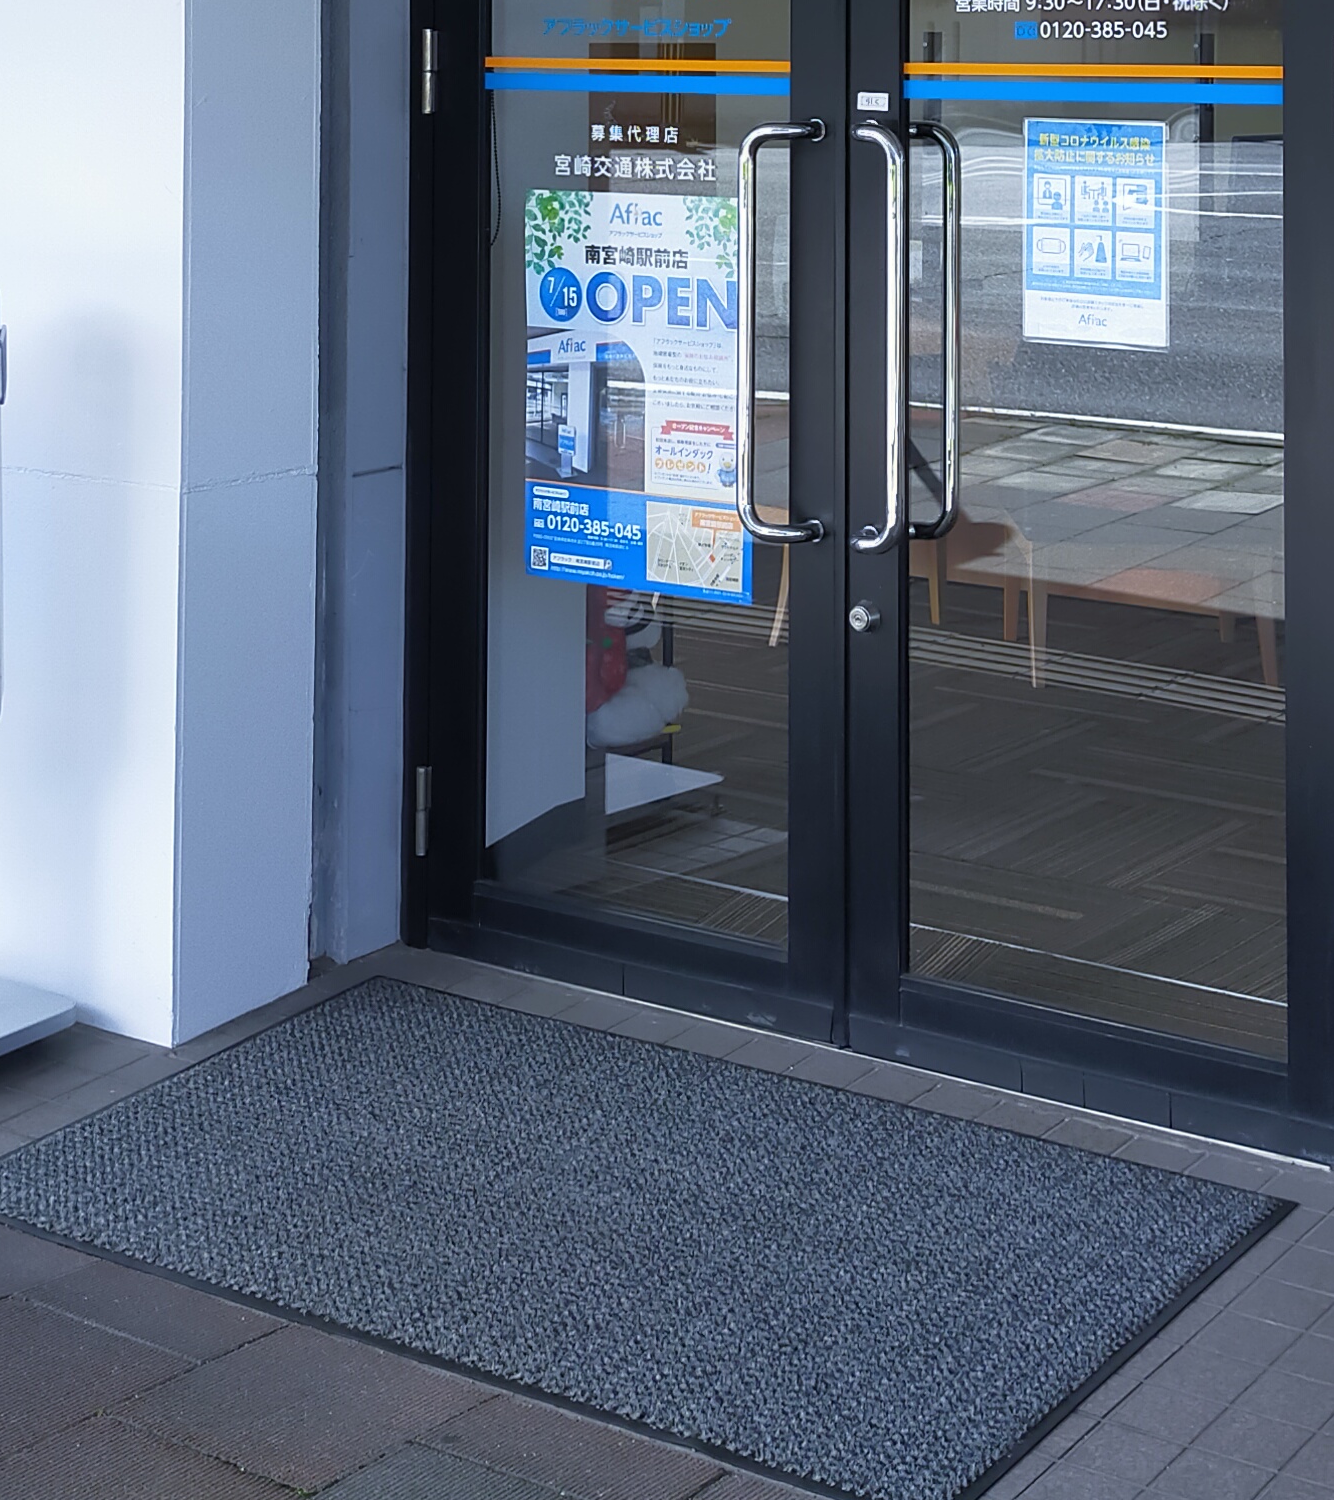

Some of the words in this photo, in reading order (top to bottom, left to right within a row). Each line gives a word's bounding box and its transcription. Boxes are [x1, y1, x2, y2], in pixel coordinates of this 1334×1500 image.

[542, 17, 733, 37] アフラックサービスショップ
[1039, 20, 1168, 40] 0120-385-045
[590, 124, 680, 144] 募集代理店
[554, 154, 717, 182] 宮崎交通株式会社
[584, 245, 689, 269] 南宮崎駅前店
[586, 271, 738, 330] OPEN
[655, 445, 714, 460] オールインダック
[533, 497, 590, 517] 南宮崎駅前店
[546, 514, 642, 541] 0120-385-045
